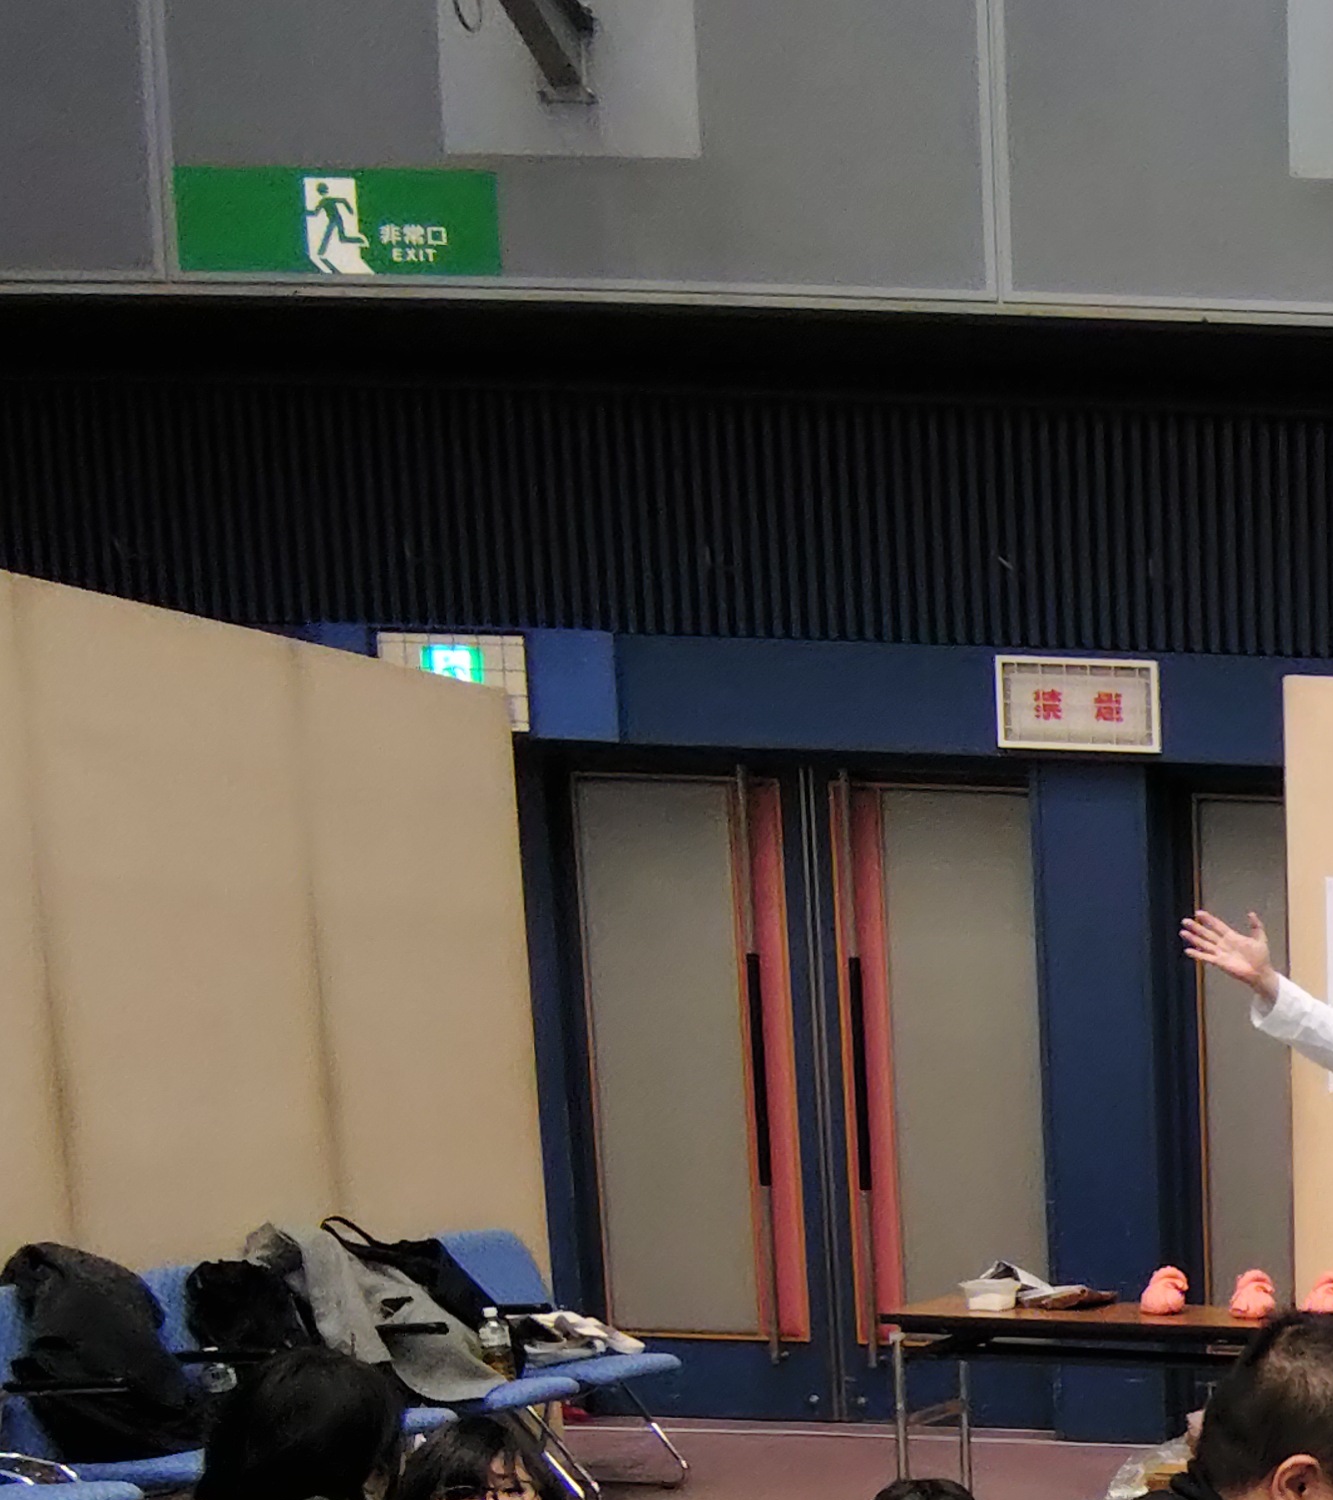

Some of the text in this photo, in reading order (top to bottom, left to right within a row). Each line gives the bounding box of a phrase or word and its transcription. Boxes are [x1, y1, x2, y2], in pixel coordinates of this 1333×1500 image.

[379, 224, 447, 246] 非常口
[392, 249, 437, 262] EXIT
